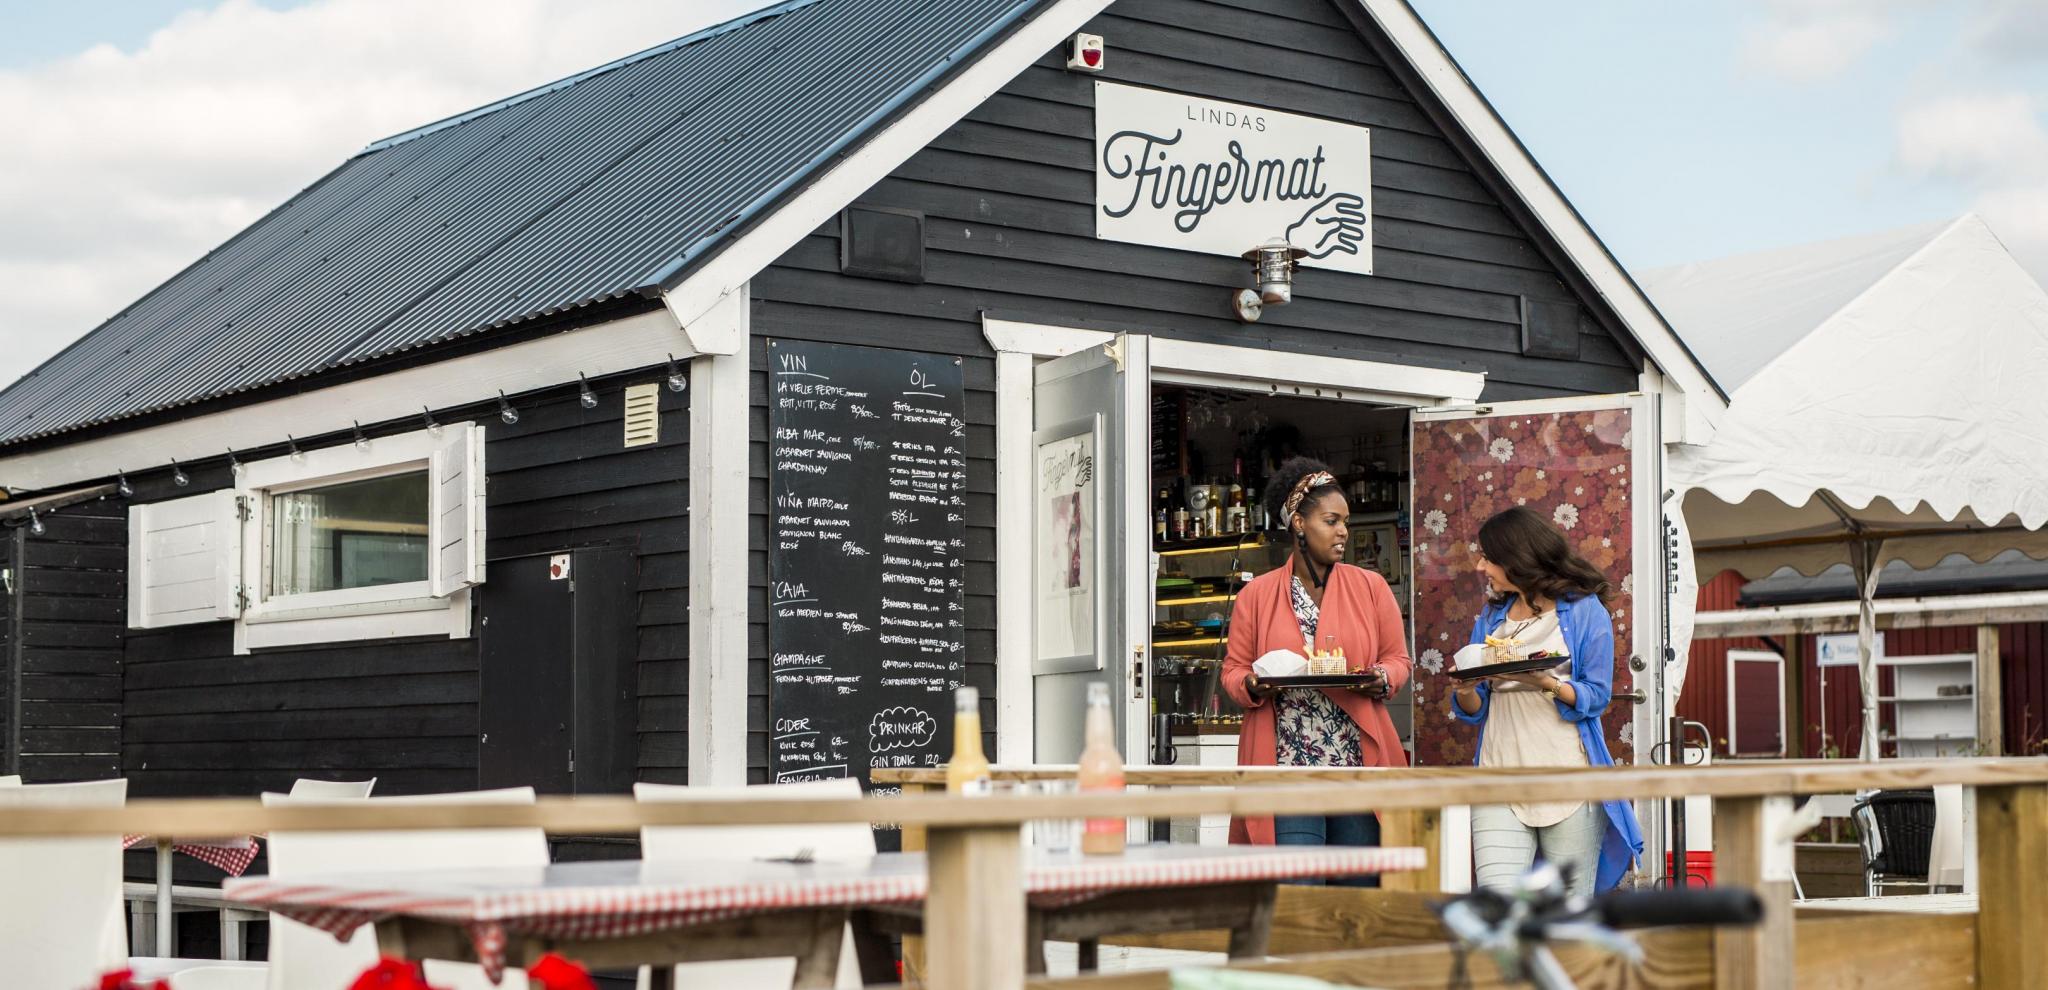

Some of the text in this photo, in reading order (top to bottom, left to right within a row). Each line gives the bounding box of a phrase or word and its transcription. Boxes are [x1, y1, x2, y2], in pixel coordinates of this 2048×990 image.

[1187, 105, 1266, 132] LINDAS
[1103, 128, 1327, 233] Fingermat
[780, 353, 807, 371] VIN
[910, 362, 936, 389] ÖL
[777, 381, 788, 392] LA
[789, 383, 813, 395] VIELLE
[776, 427, 799, 440] ALBA
[816, 449, 852, 462] SAUVIGNON
[777, 461, 828, 475] CHARDONNAY
[777, 491, 803, 509] VIÑA
[779, 529, 842, 540] SAUVIGNON BLANC
[780, 540, 799, 550] ROSÉ
[776, 581, 809, 599] CAVA
[778, 608, 795, 618] VEGA
[773, 653, 826, 666] CHAMPAGNE
[775, 717, 811, 733] CIDER
[879, 721, 926, 736] DRINKAR
[870, 755, 889, 769] GIN
[891, 754, 916, 766] TONIC
